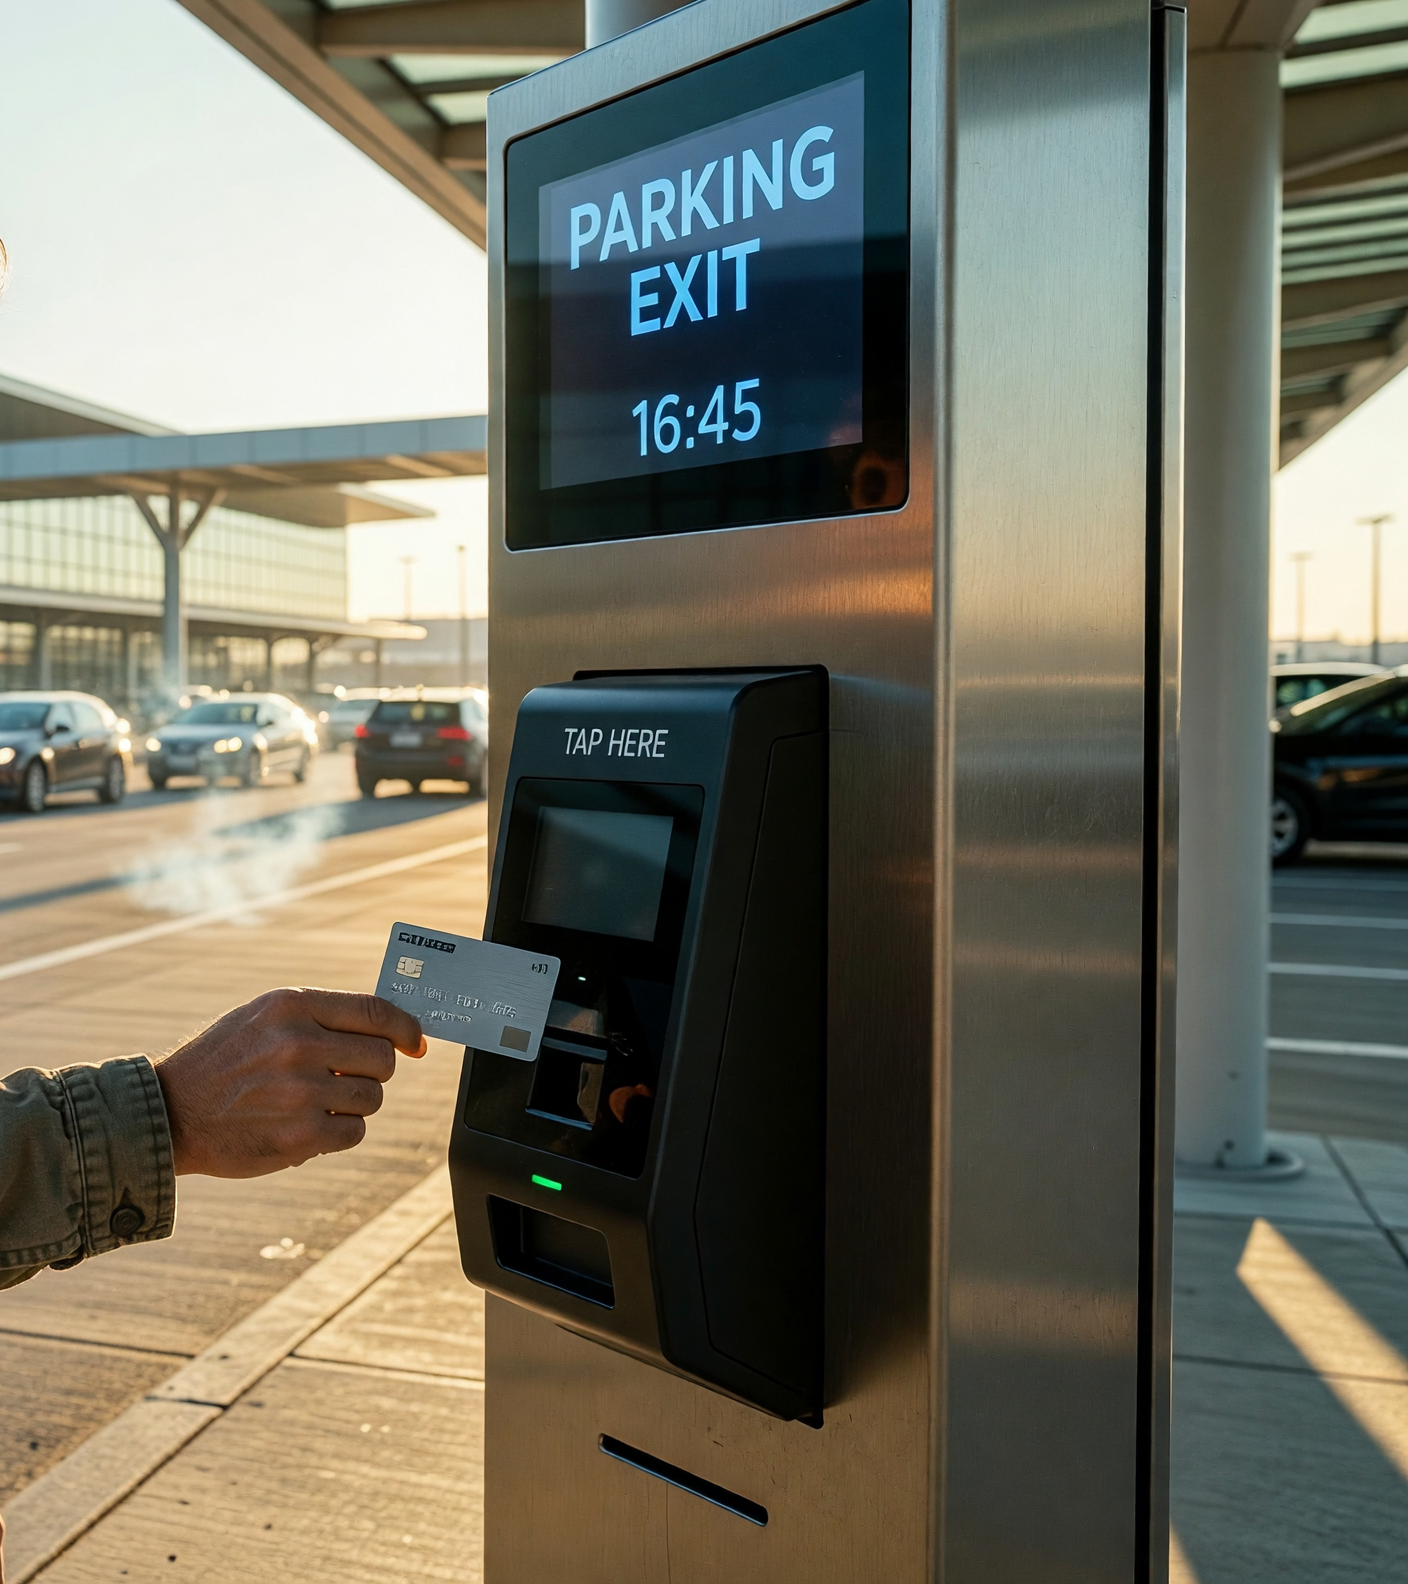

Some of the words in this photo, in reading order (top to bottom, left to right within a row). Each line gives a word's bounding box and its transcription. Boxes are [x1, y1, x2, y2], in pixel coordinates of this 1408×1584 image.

[570, 125, 835, 271] PARKING
[630, 237, 761, 337] EXIT
[632, 378, 762, 457] 16:45
[564, 727, 603, 756] TAP
[607, 728, 669, 758] HERE
